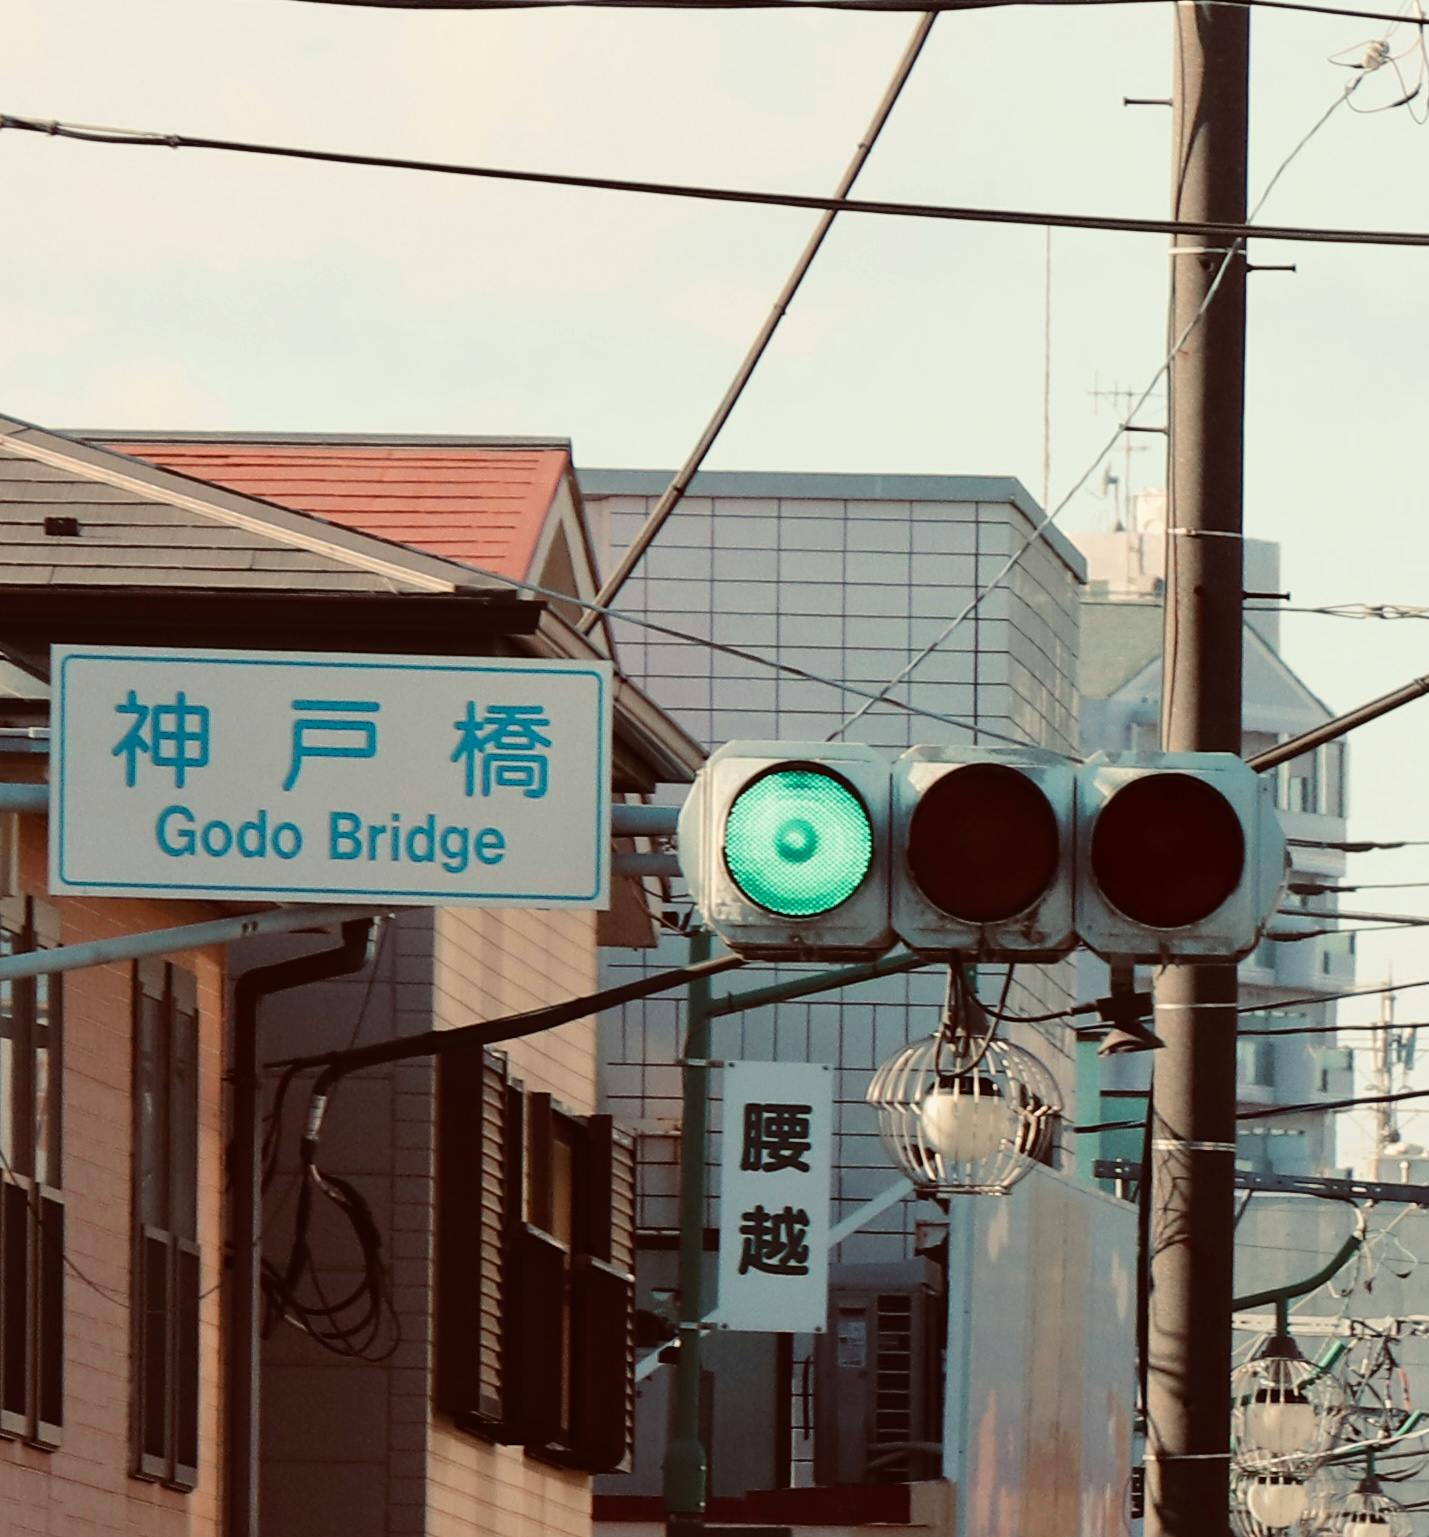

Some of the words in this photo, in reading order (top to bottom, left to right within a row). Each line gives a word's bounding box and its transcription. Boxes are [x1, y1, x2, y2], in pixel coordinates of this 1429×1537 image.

[112, 690, 553, 799] 神戸橋
[155, 804, 304, 860] Godo
[329, 811, 507, 874] Bridge
[740, 1102, 813, 1278] 腰越
